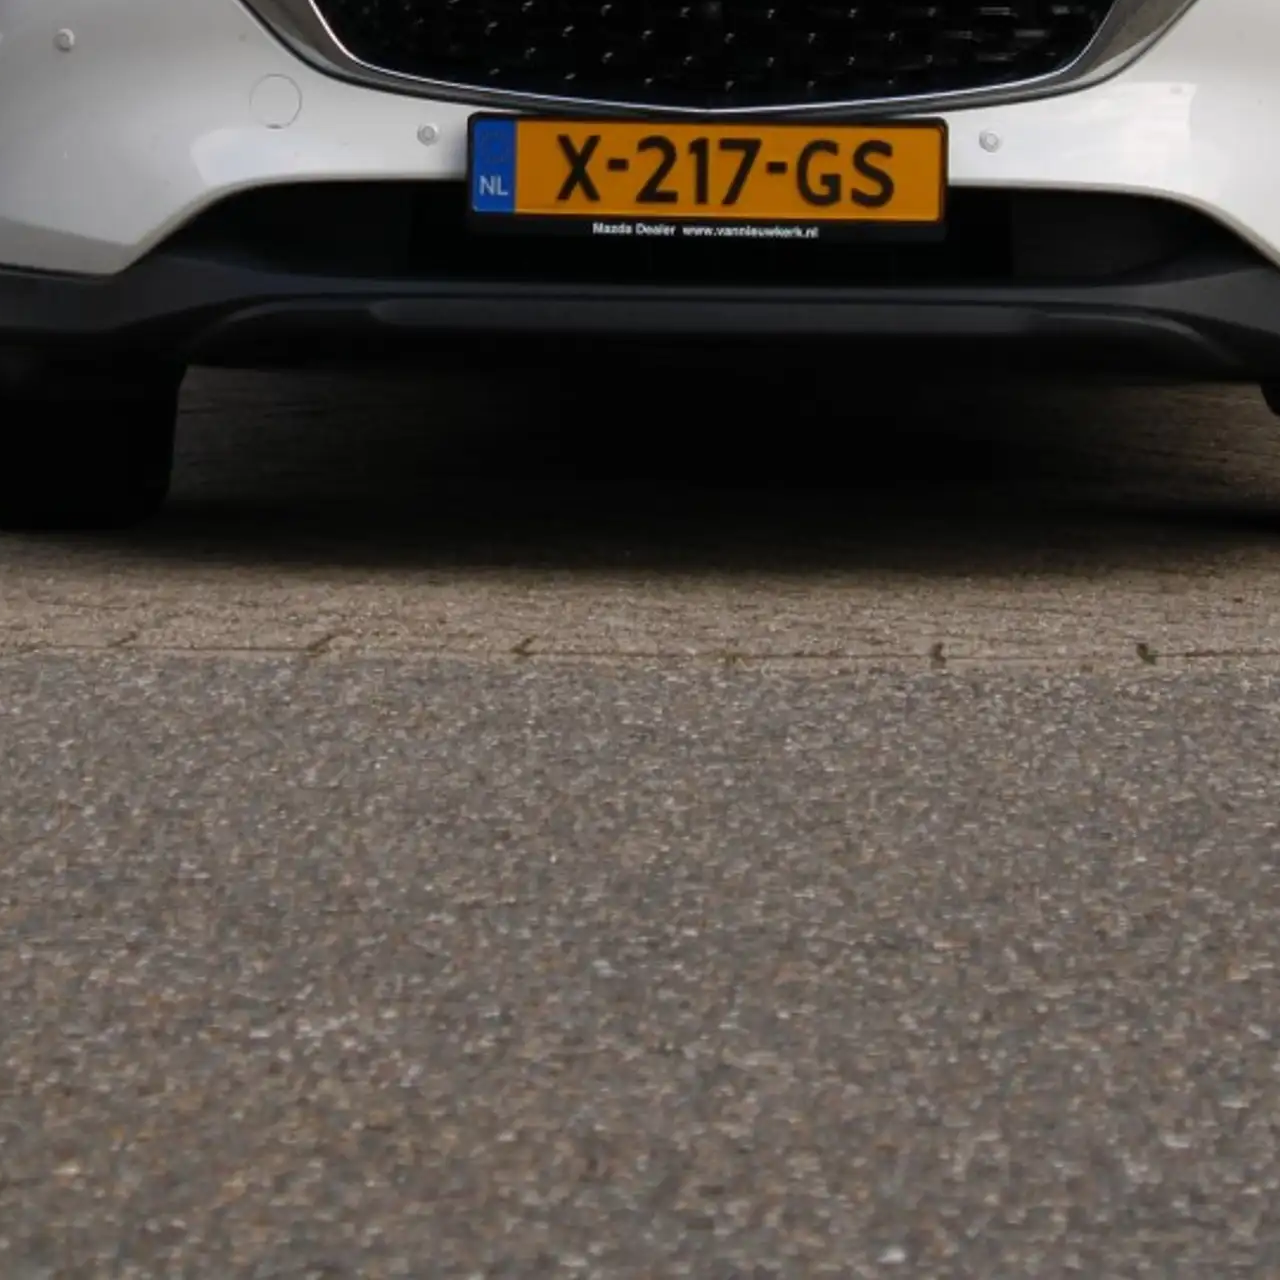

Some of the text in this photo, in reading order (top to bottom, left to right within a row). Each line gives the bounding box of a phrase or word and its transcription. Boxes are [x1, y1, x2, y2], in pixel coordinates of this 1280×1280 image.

[556, 134, 895, 208] X-217-GS
[479, 175, 509, 197] NL
[592, 223, 632, 235] Mazda
[635, 223, 676, 237] Dealer
